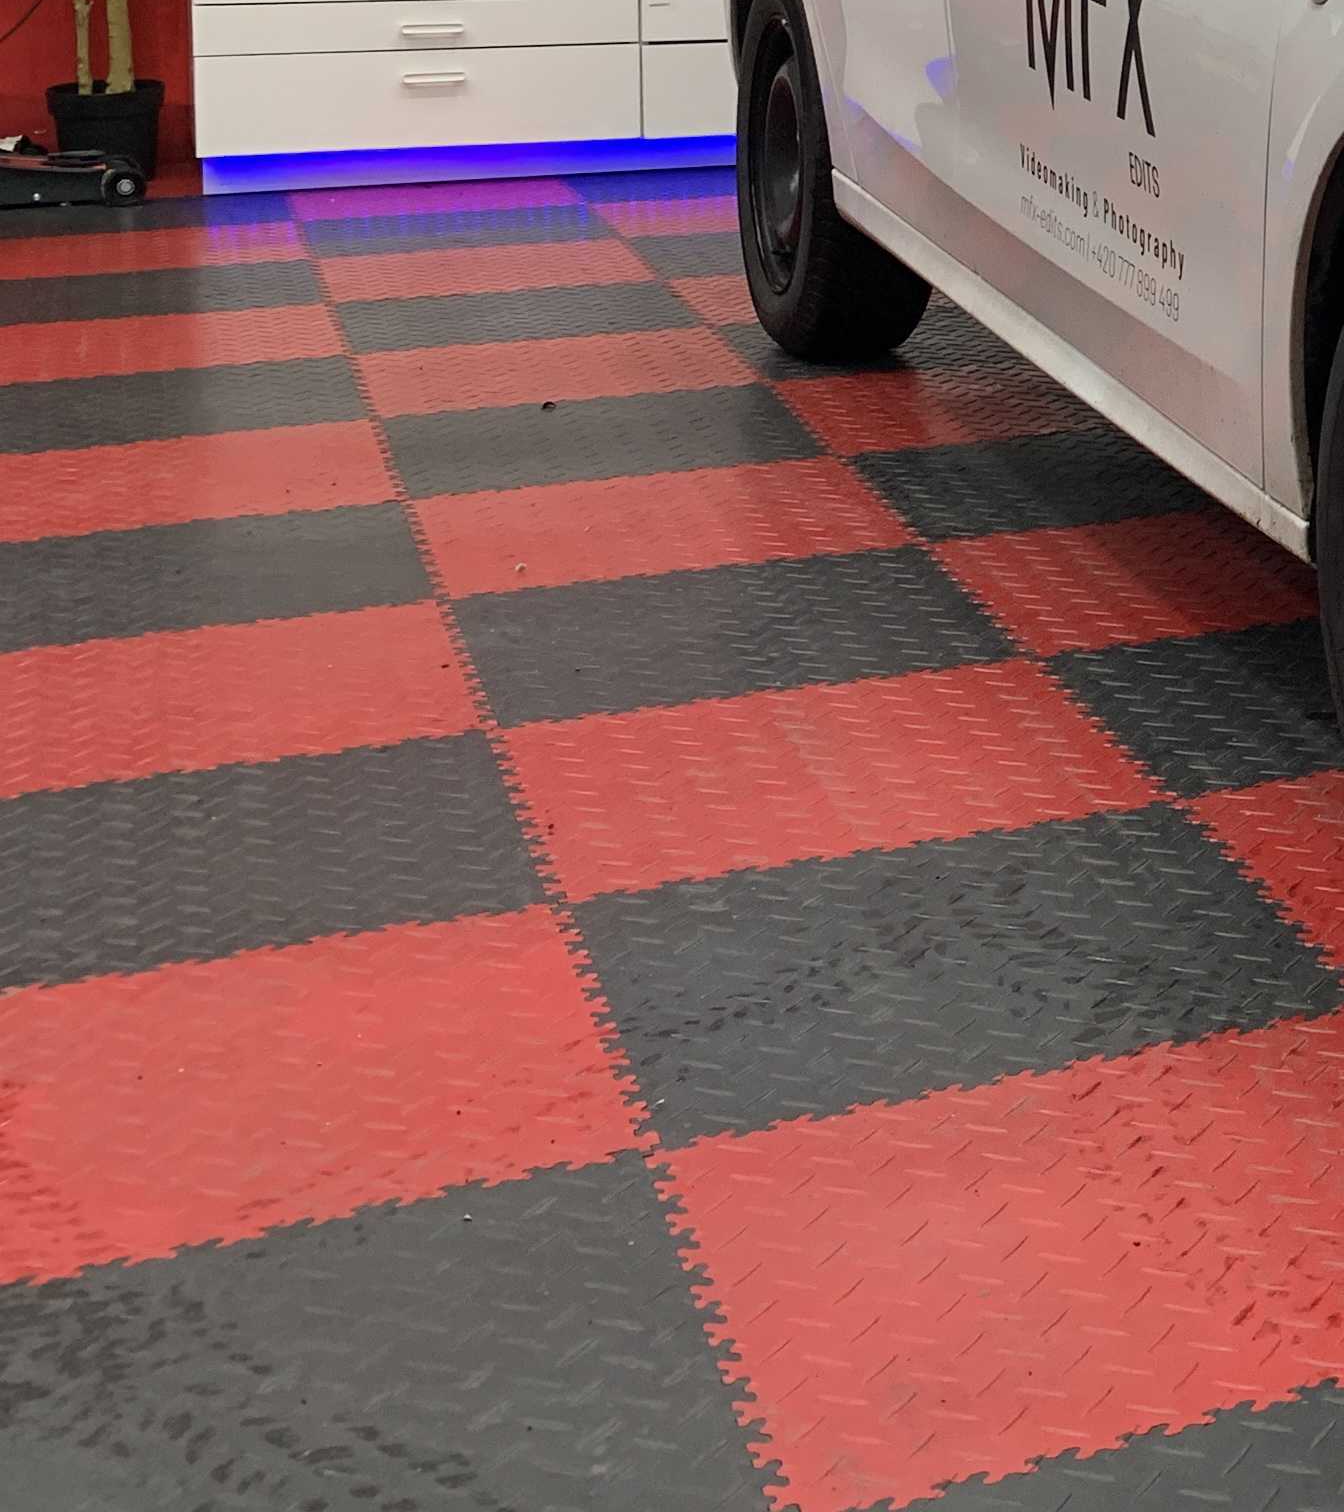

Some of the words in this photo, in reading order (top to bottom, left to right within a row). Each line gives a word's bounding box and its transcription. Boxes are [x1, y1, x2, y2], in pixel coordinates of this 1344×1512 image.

[1128, 151, 1161, 199] EDITS
[1019, 143, 1089, 218] Videomaking
[1103, 198, 1185, 281] Photography
[1117, 255, 1136, 289] 777
